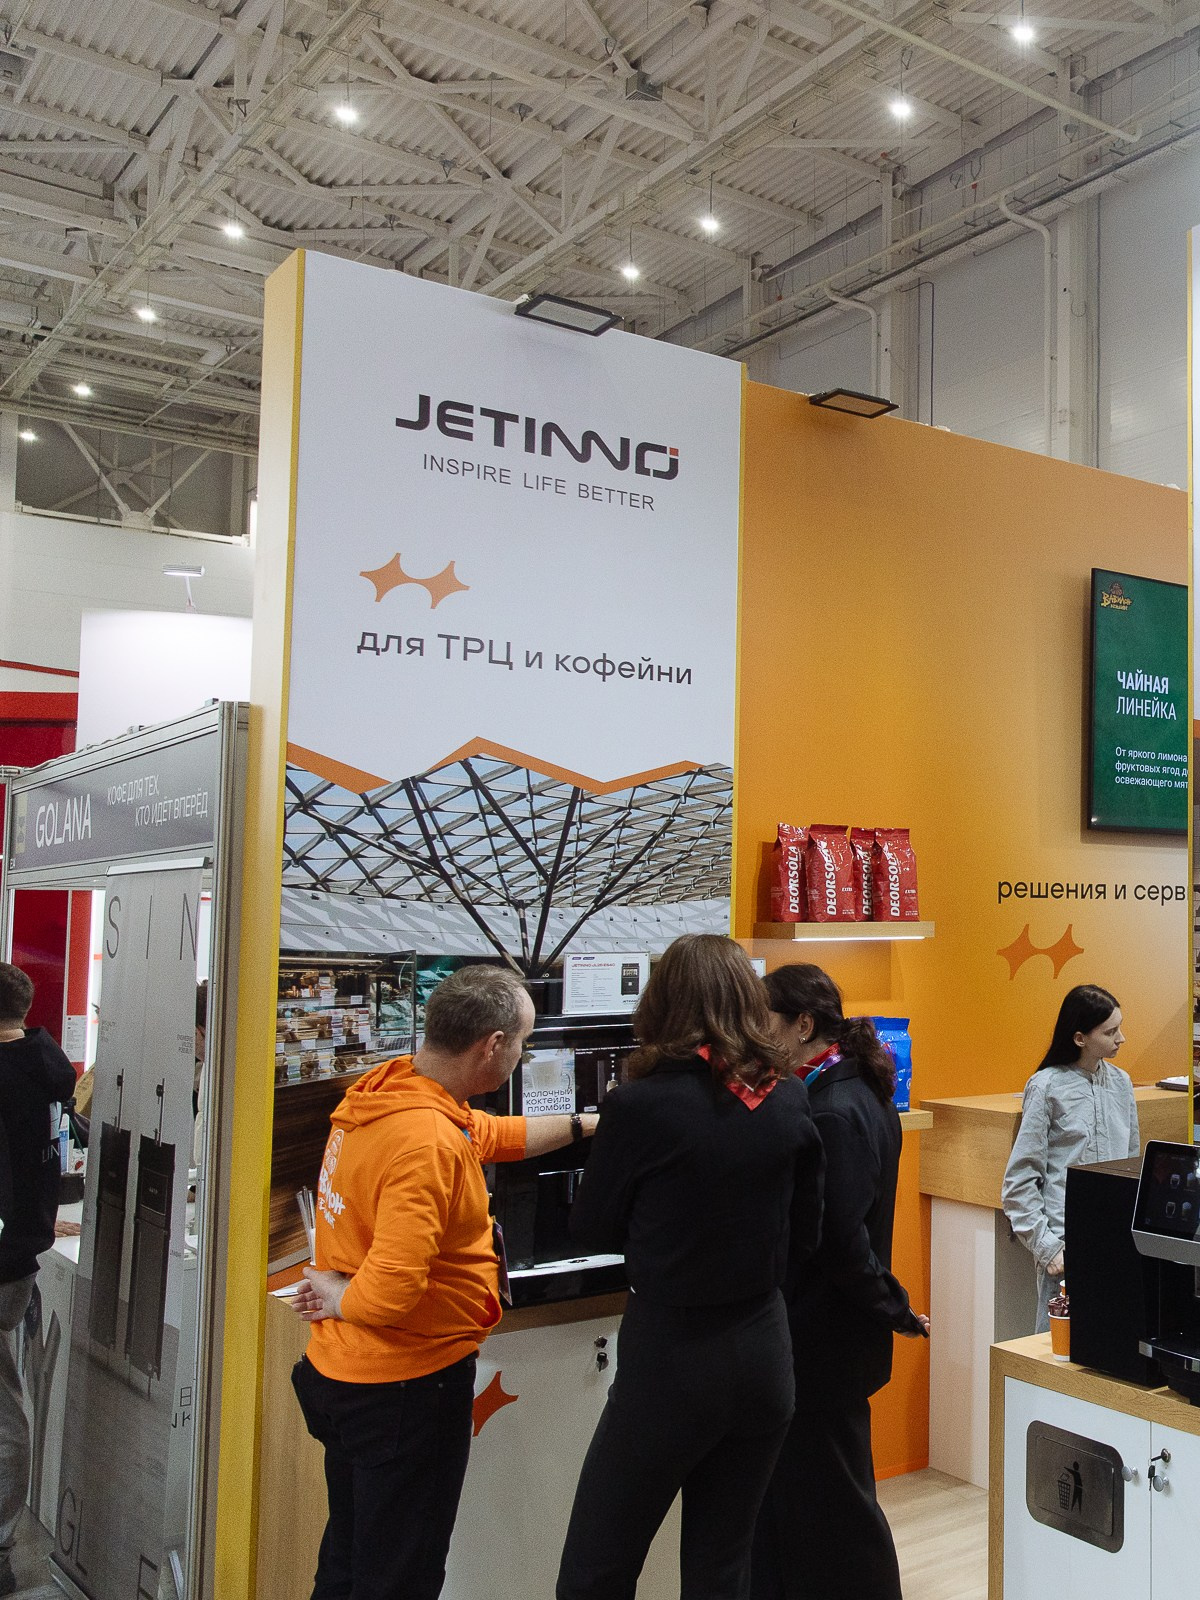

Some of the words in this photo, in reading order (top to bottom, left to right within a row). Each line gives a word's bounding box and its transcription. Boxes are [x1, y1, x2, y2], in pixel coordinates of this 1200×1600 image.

[395, 393, 679, 481] JETINNO
[423, 453, 511, 485] INSPIRE
[523, 472, 566, 495] LIFE
[578, 483, 655, 511] BETTER
[357, 631, 425, 657] для
[437, 633, 514, 671] ТРЦ
[525, 650, 544, 670] и
[555, 653, 693, 685] кофейни
[1116, 668, 1169, 695] ЧАЙНАЯ
[1115, 695, 1177, 721] ЛИНЕЙКА
[1115, 746, 1126, 757] От
[1128, 749, 1156, 760] яркого
[1114, 775, 1173, 788] освежающего
[1115, 760, 1161, 773] фруктовых
[1162, 766, 1181, 777] ягод
[107, 783, 127, 806] КОФЕ
[127, 778, 144, 805] ДЛЯ
[135, 804, 151, 826] КТО
[174, 788, 208, 819] ВПЕРЁД
[36, 794, 92, 849] GOLANA
[788, 846, 800, 914] DEORSOLA
[998, 880, 1108, 905] решения
[1114, 884, 1127, 900] и
[1133, 884, 1187, 906] серв
[523, 1088, 573, 1099] молочный
[526, 1096, 571, 1106] коктейль
[527, 1103, 571, 1113] пломбир
